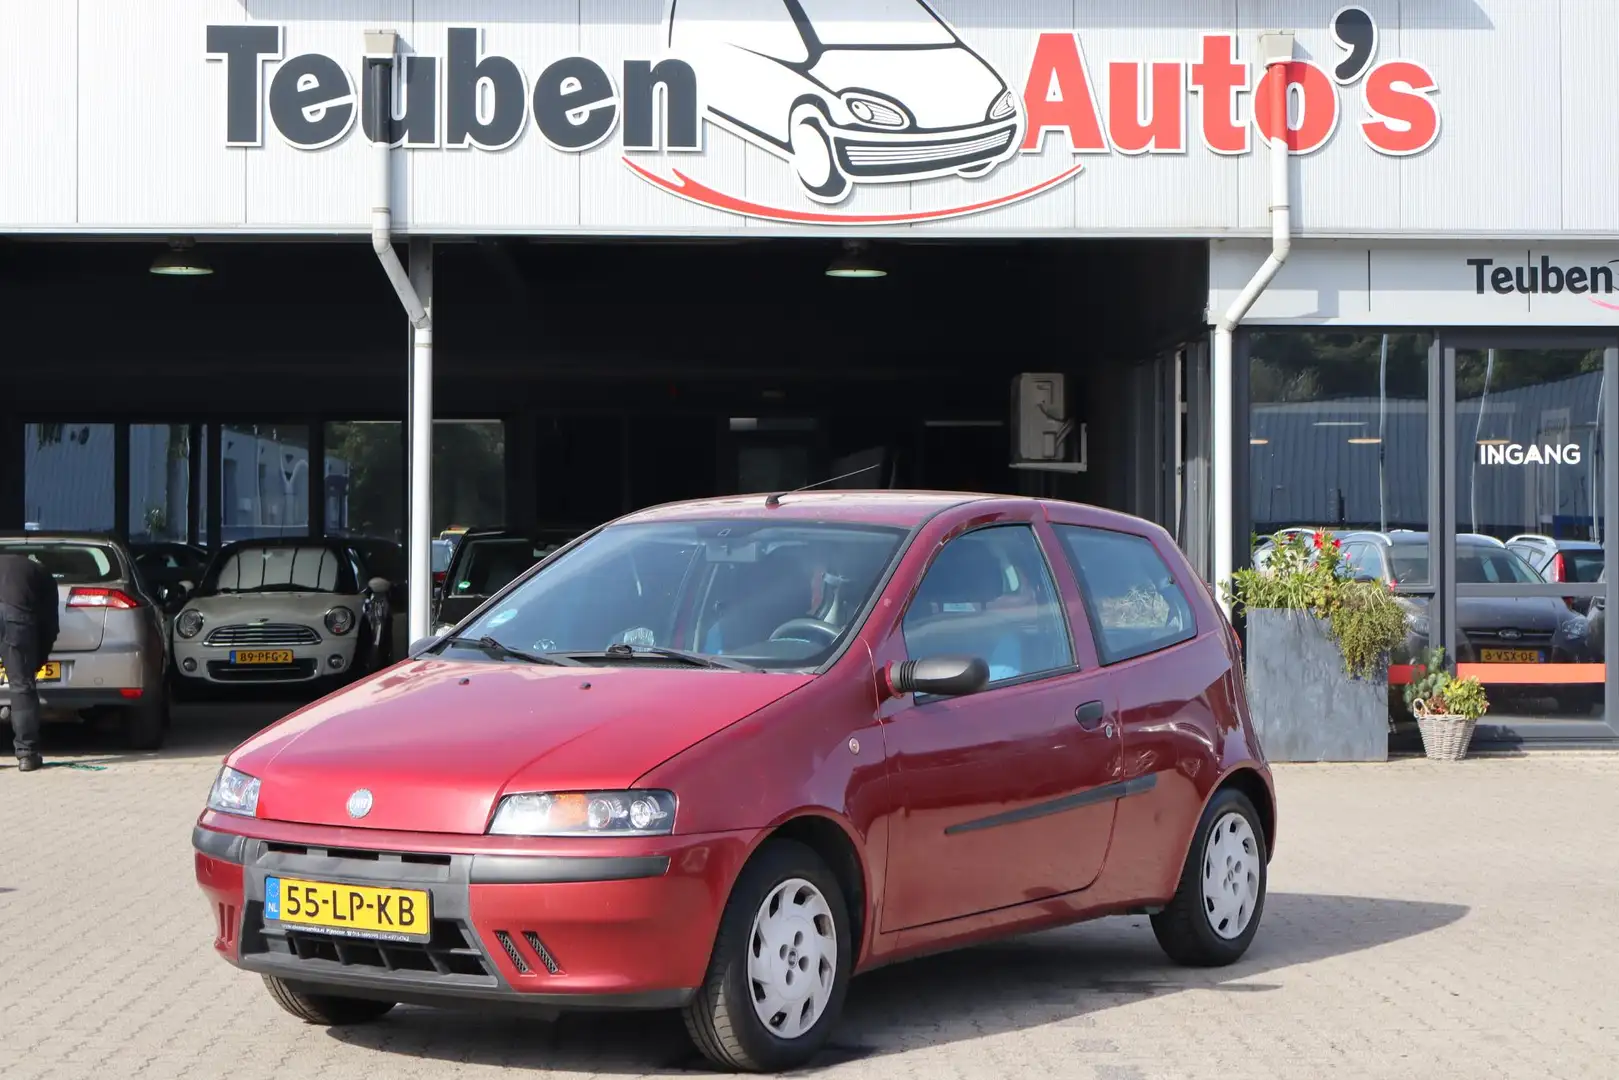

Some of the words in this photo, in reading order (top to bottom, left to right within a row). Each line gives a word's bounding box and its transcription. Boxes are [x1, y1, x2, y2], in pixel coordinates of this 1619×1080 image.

[206, 25, 698, 149] Teuben
[1021, 8, 1440, 151] Auto's
[1466, 255, 1613, 295] Teuben
[1480, 443, 1581, 465] INGANG
[240, 651, 289, 662] 89-PFG-2
[267, 902, 279, 913] NL
[287, 885, 415, 926] 55-LP-KB
